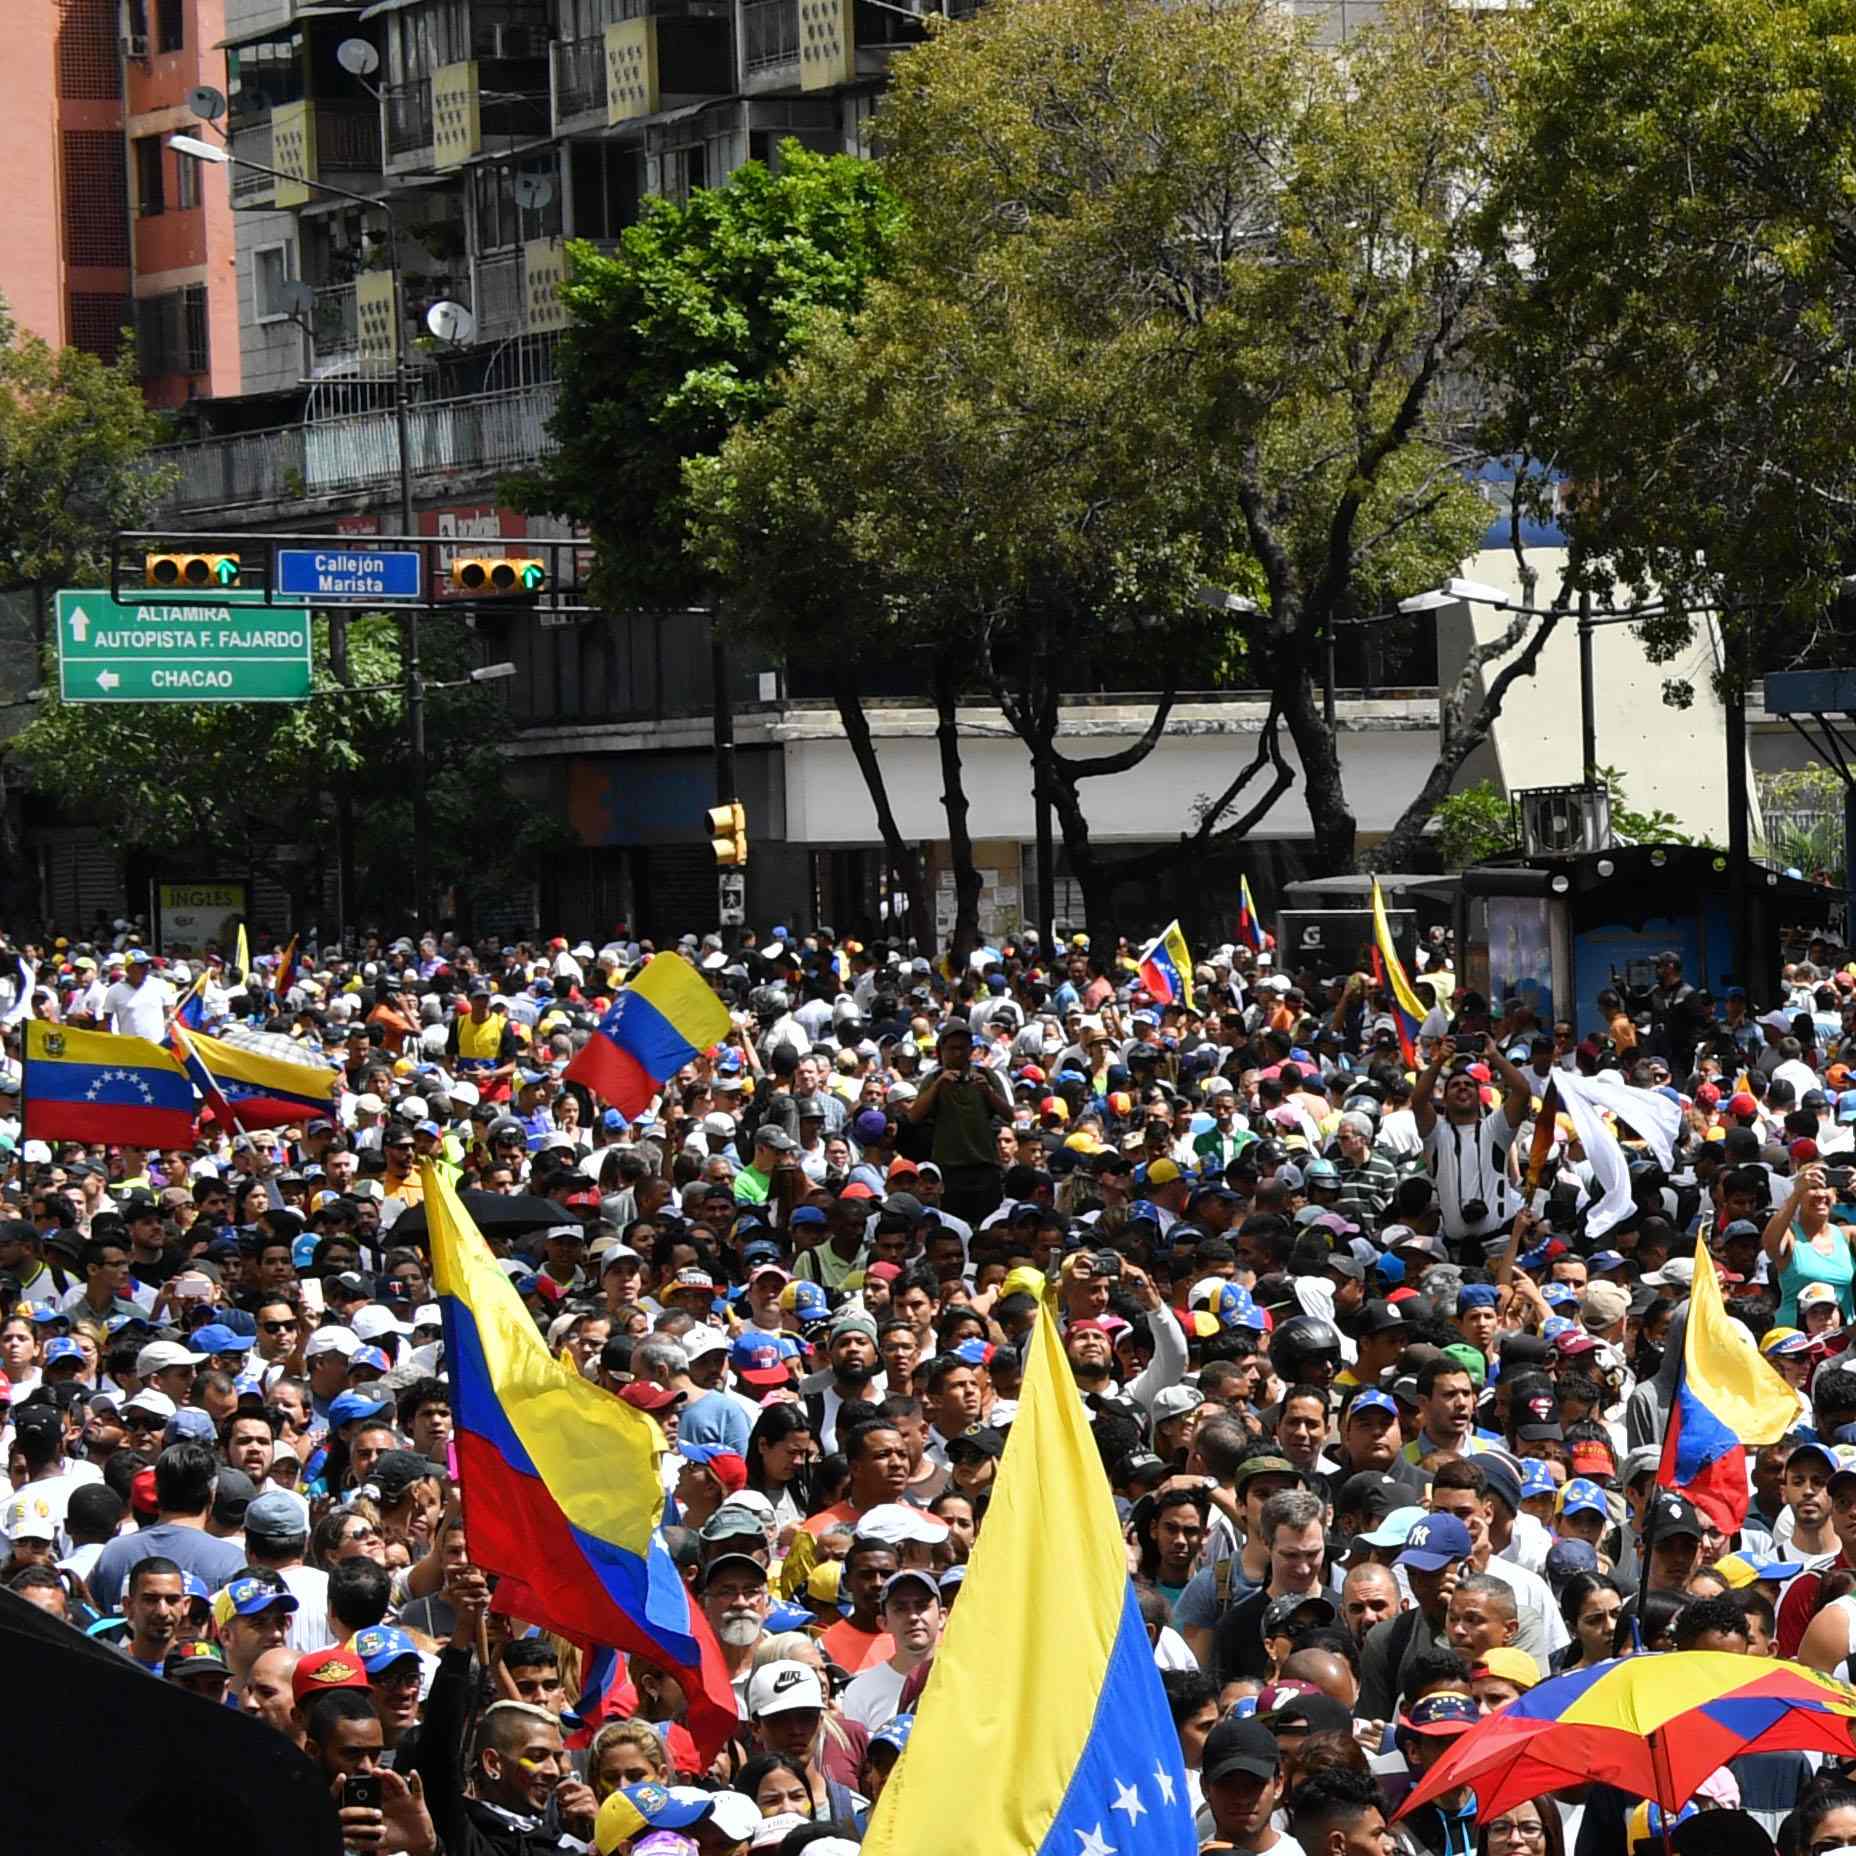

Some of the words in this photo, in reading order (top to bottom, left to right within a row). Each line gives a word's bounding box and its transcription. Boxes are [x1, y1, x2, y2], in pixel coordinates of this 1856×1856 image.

[315, 554, 384, 574] Callejón
[318, 575, 384, 592] Marista
[136, 605, 231, 622] ALTAMIRA
[95, 630, 197, 648] AUTOPISTA
[201, 631, 215, 648] F.
[219, 630, 304, 649] FAJARDO
[151, 669, 233, 688] CHACAO
[778, 1670, 802, 1682] NIKE
